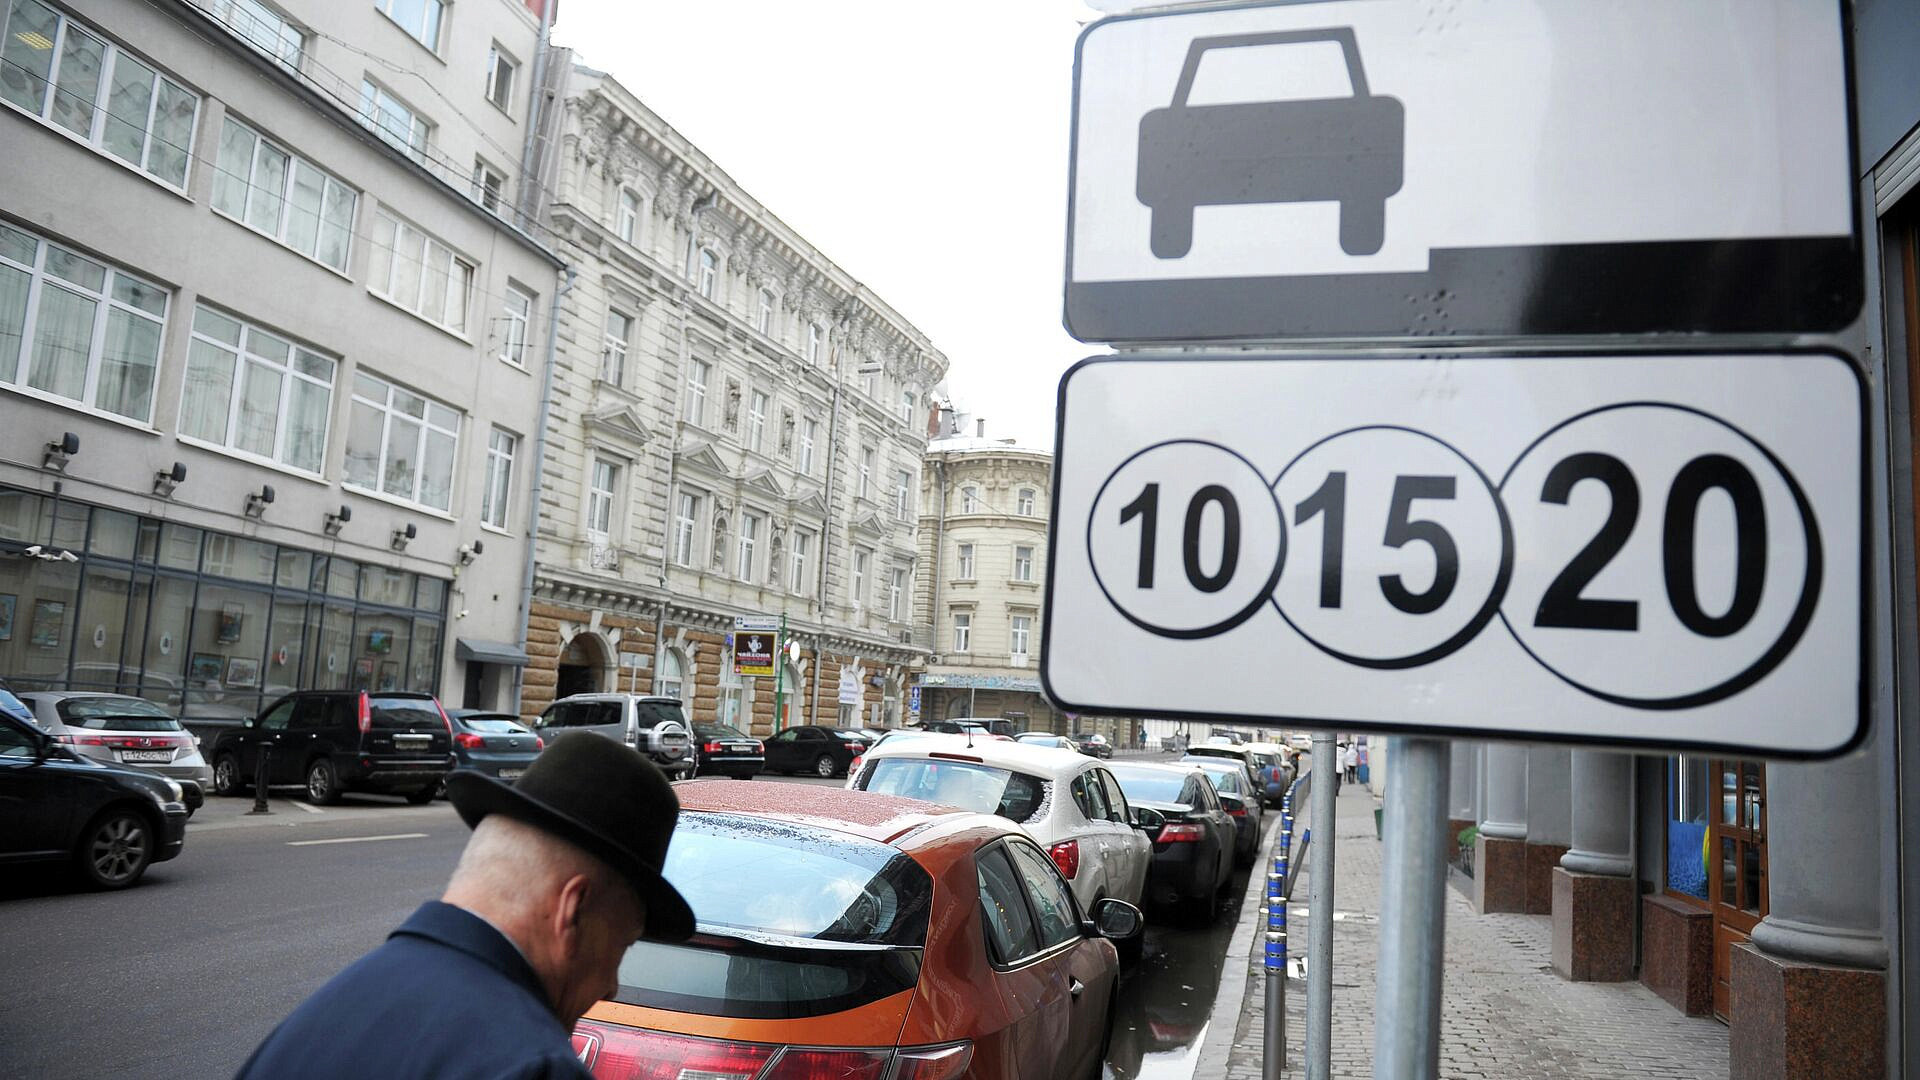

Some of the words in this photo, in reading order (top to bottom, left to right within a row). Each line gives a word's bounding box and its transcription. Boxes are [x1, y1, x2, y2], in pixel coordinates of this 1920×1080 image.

[1119, 483, 1241, 594] 10
[1294, 472, 1459, 616] 15
[1533, 451, 1769, 639] 20
